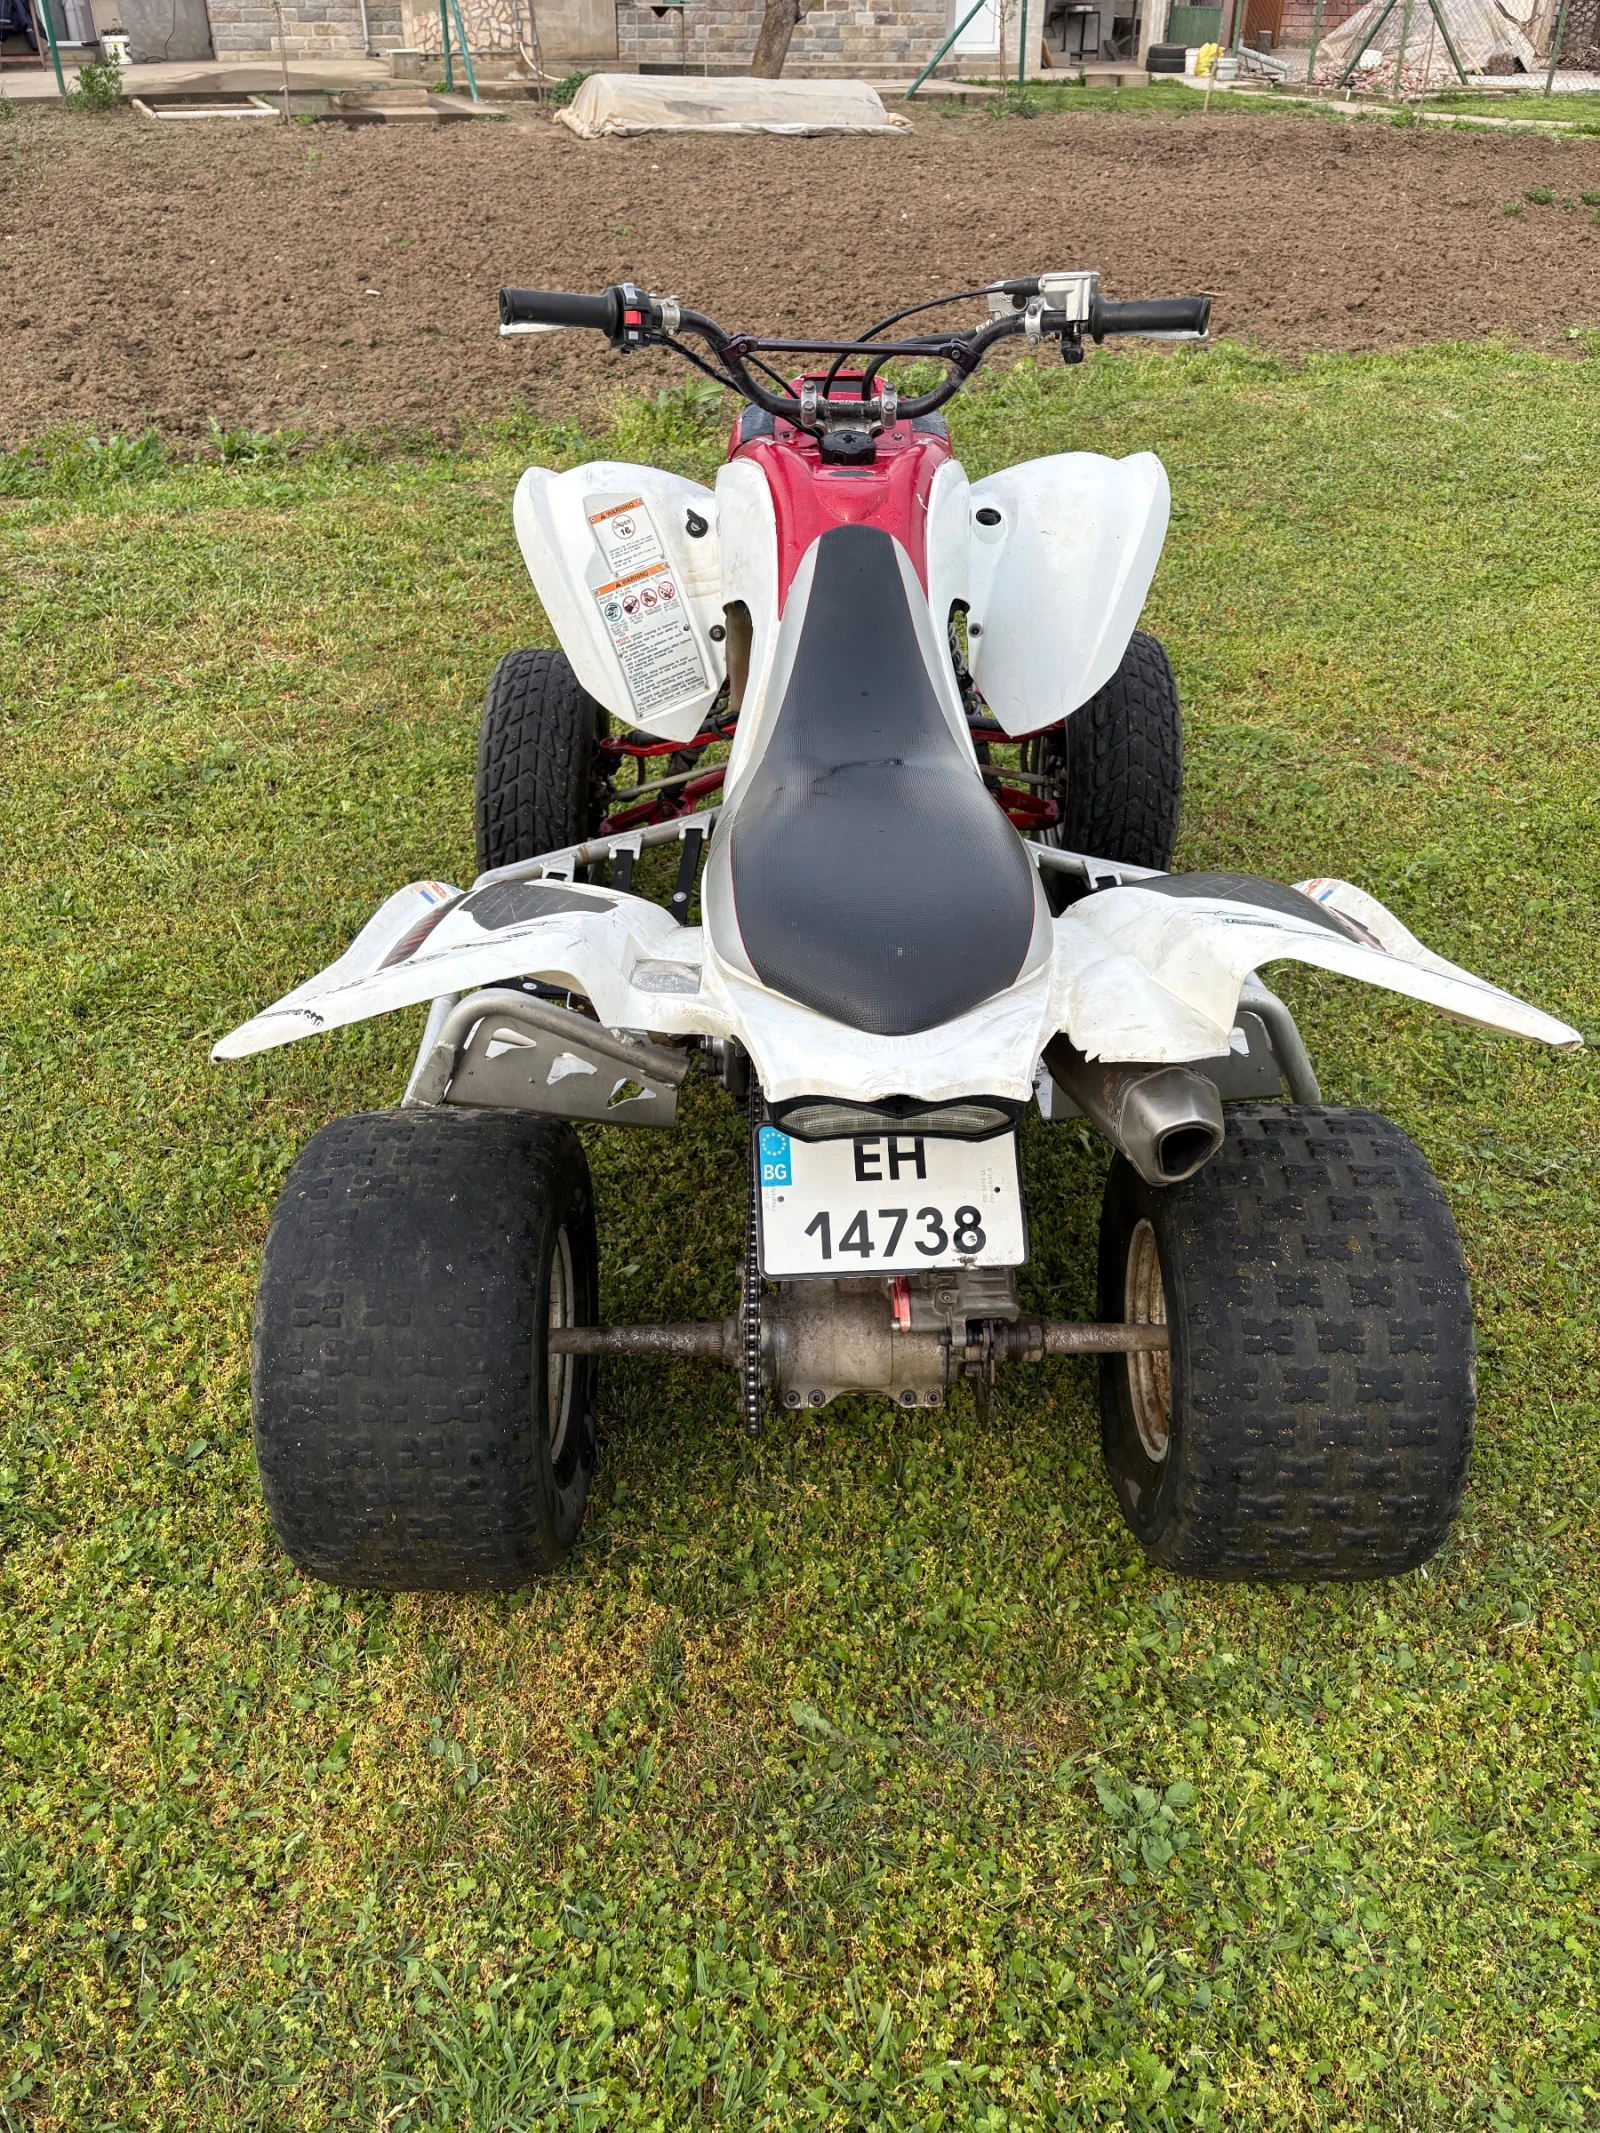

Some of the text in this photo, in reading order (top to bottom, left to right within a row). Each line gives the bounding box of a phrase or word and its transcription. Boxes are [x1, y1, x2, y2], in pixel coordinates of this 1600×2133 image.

[607, 502, 634, 517] WARNING
[621, 527, 631, 536] 16
[623, 571, 649, 586] WARNING
[853, 1138, 927, 1181] EH
[764, 1164, 787, 1180] BG
[804, 1205, 986, 1260] 14738
